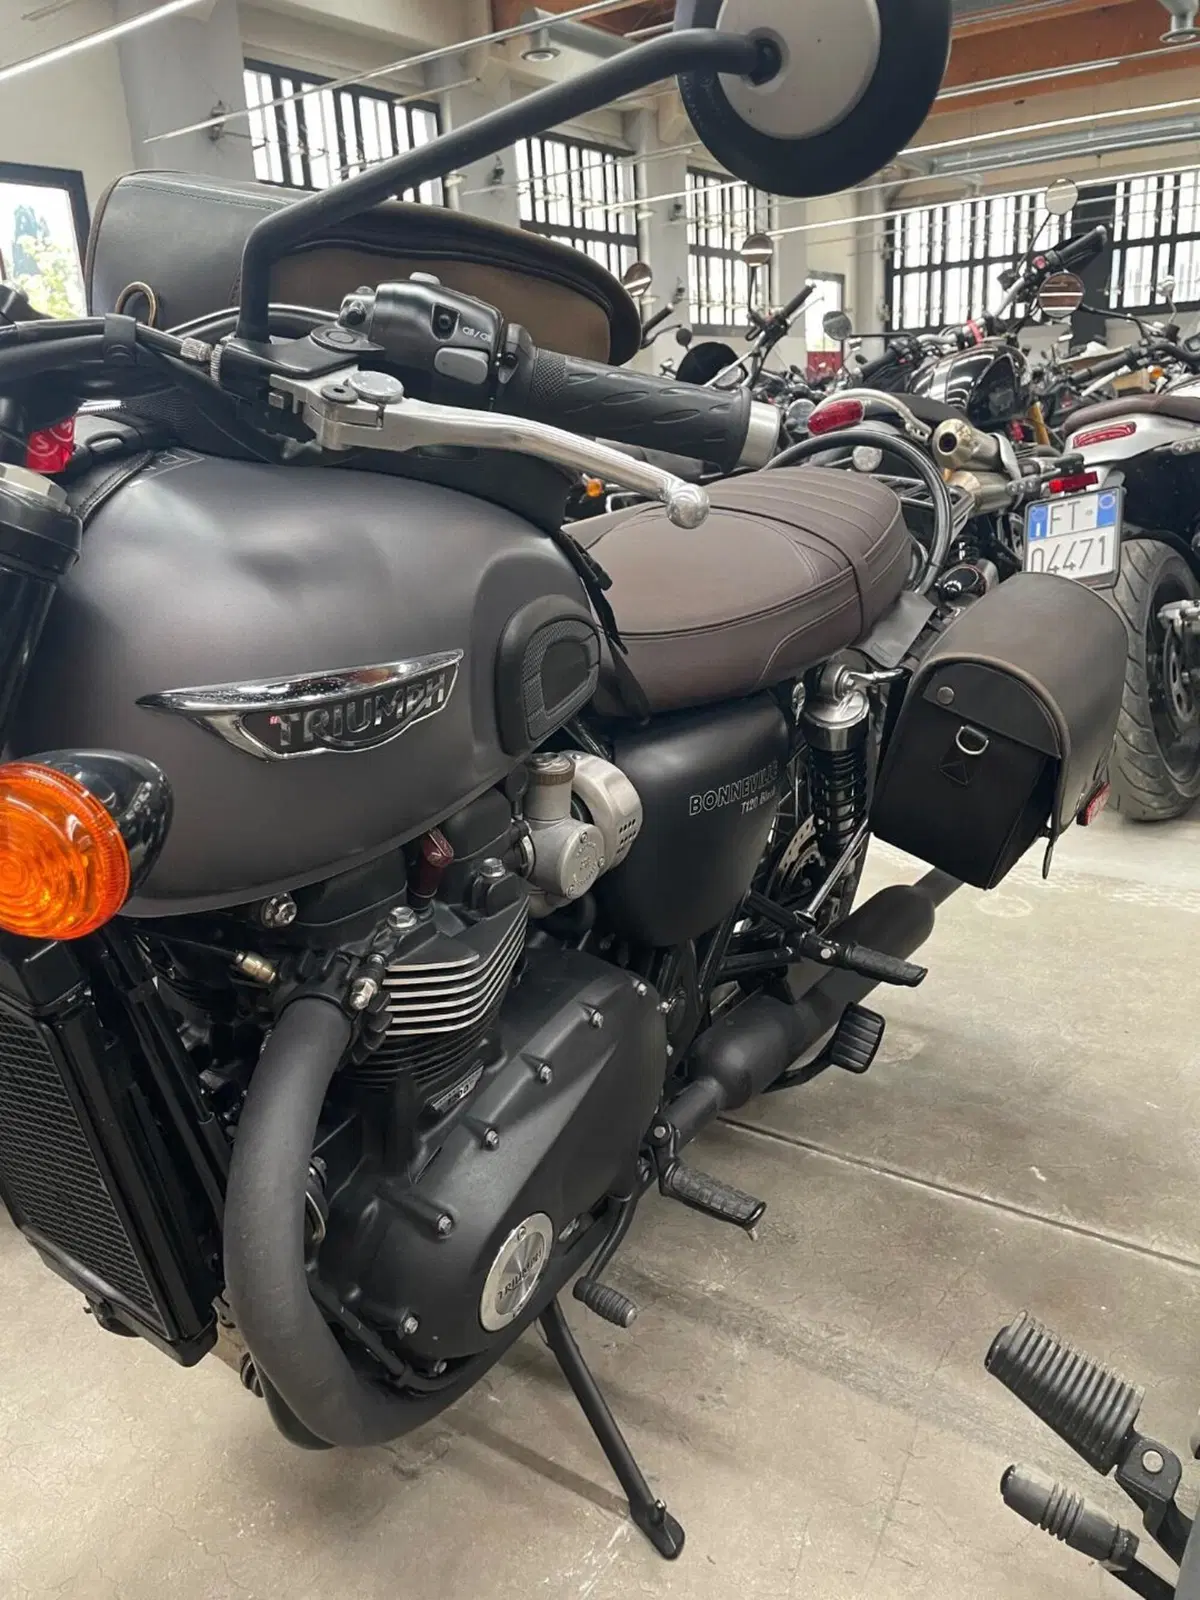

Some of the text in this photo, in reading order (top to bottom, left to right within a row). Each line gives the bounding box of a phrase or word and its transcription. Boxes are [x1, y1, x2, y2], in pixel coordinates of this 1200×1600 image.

[1049, 500, 1081, 535] FT
[1030, 535, 1107, 574] 04471
[270, 672, 447, 747] TRIUMPH
